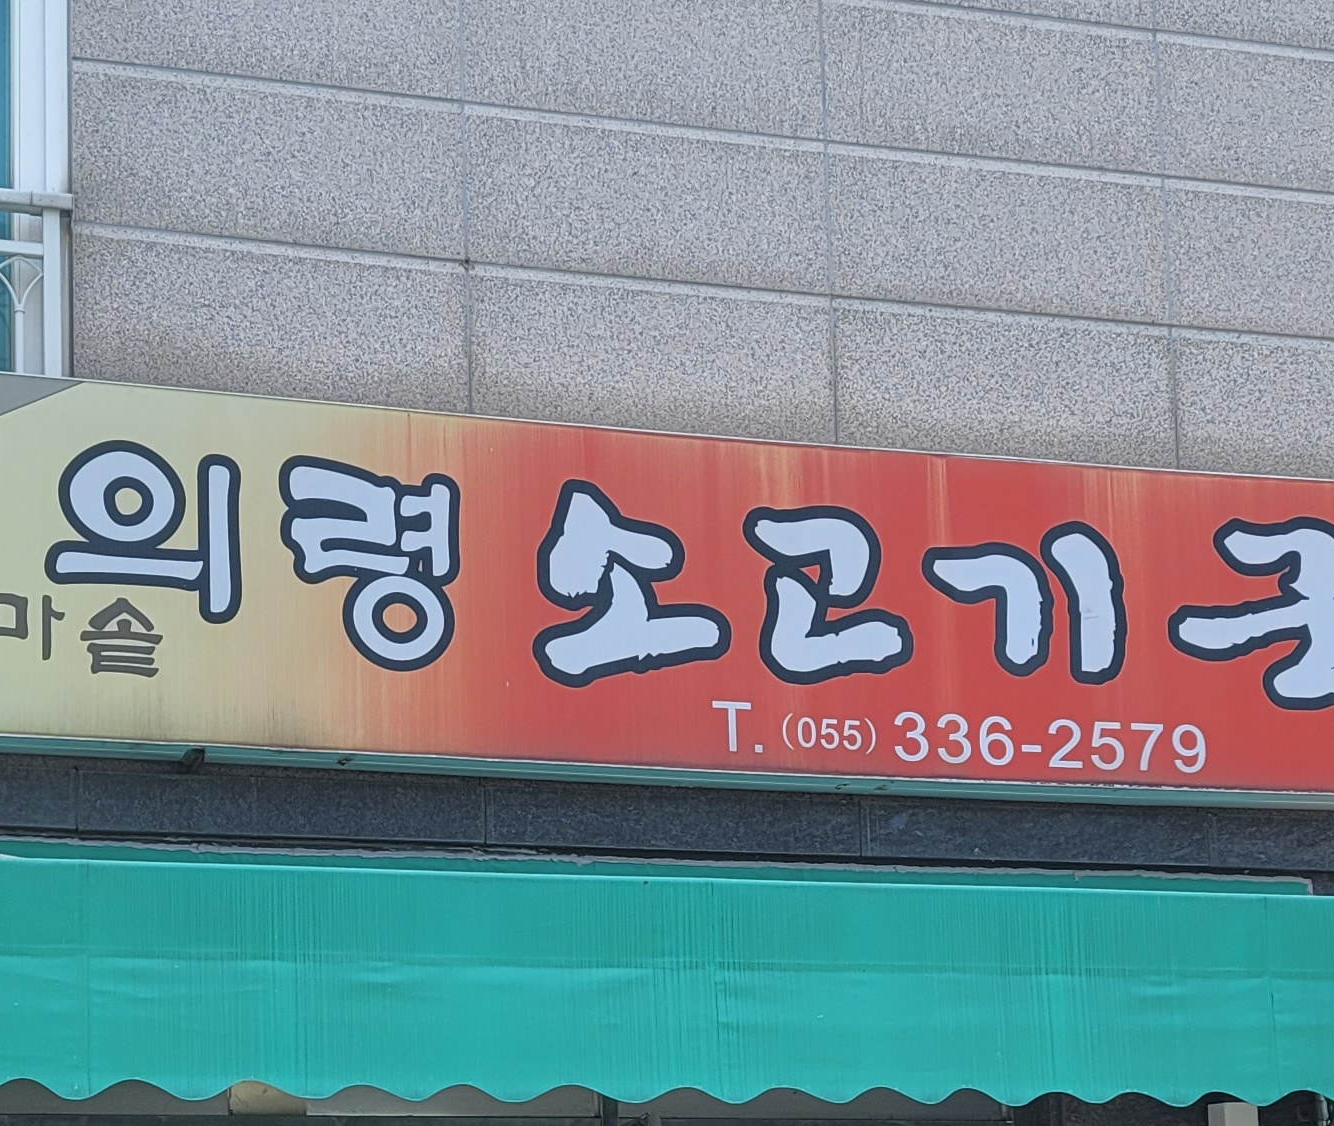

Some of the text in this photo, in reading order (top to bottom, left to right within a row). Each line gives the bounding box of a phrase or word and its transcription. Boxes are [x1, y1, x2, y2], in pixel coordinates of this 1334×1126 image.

[45, 440, 460, 672] 의령
[711, 701, 1207, 774] T. (055) 336-2579
